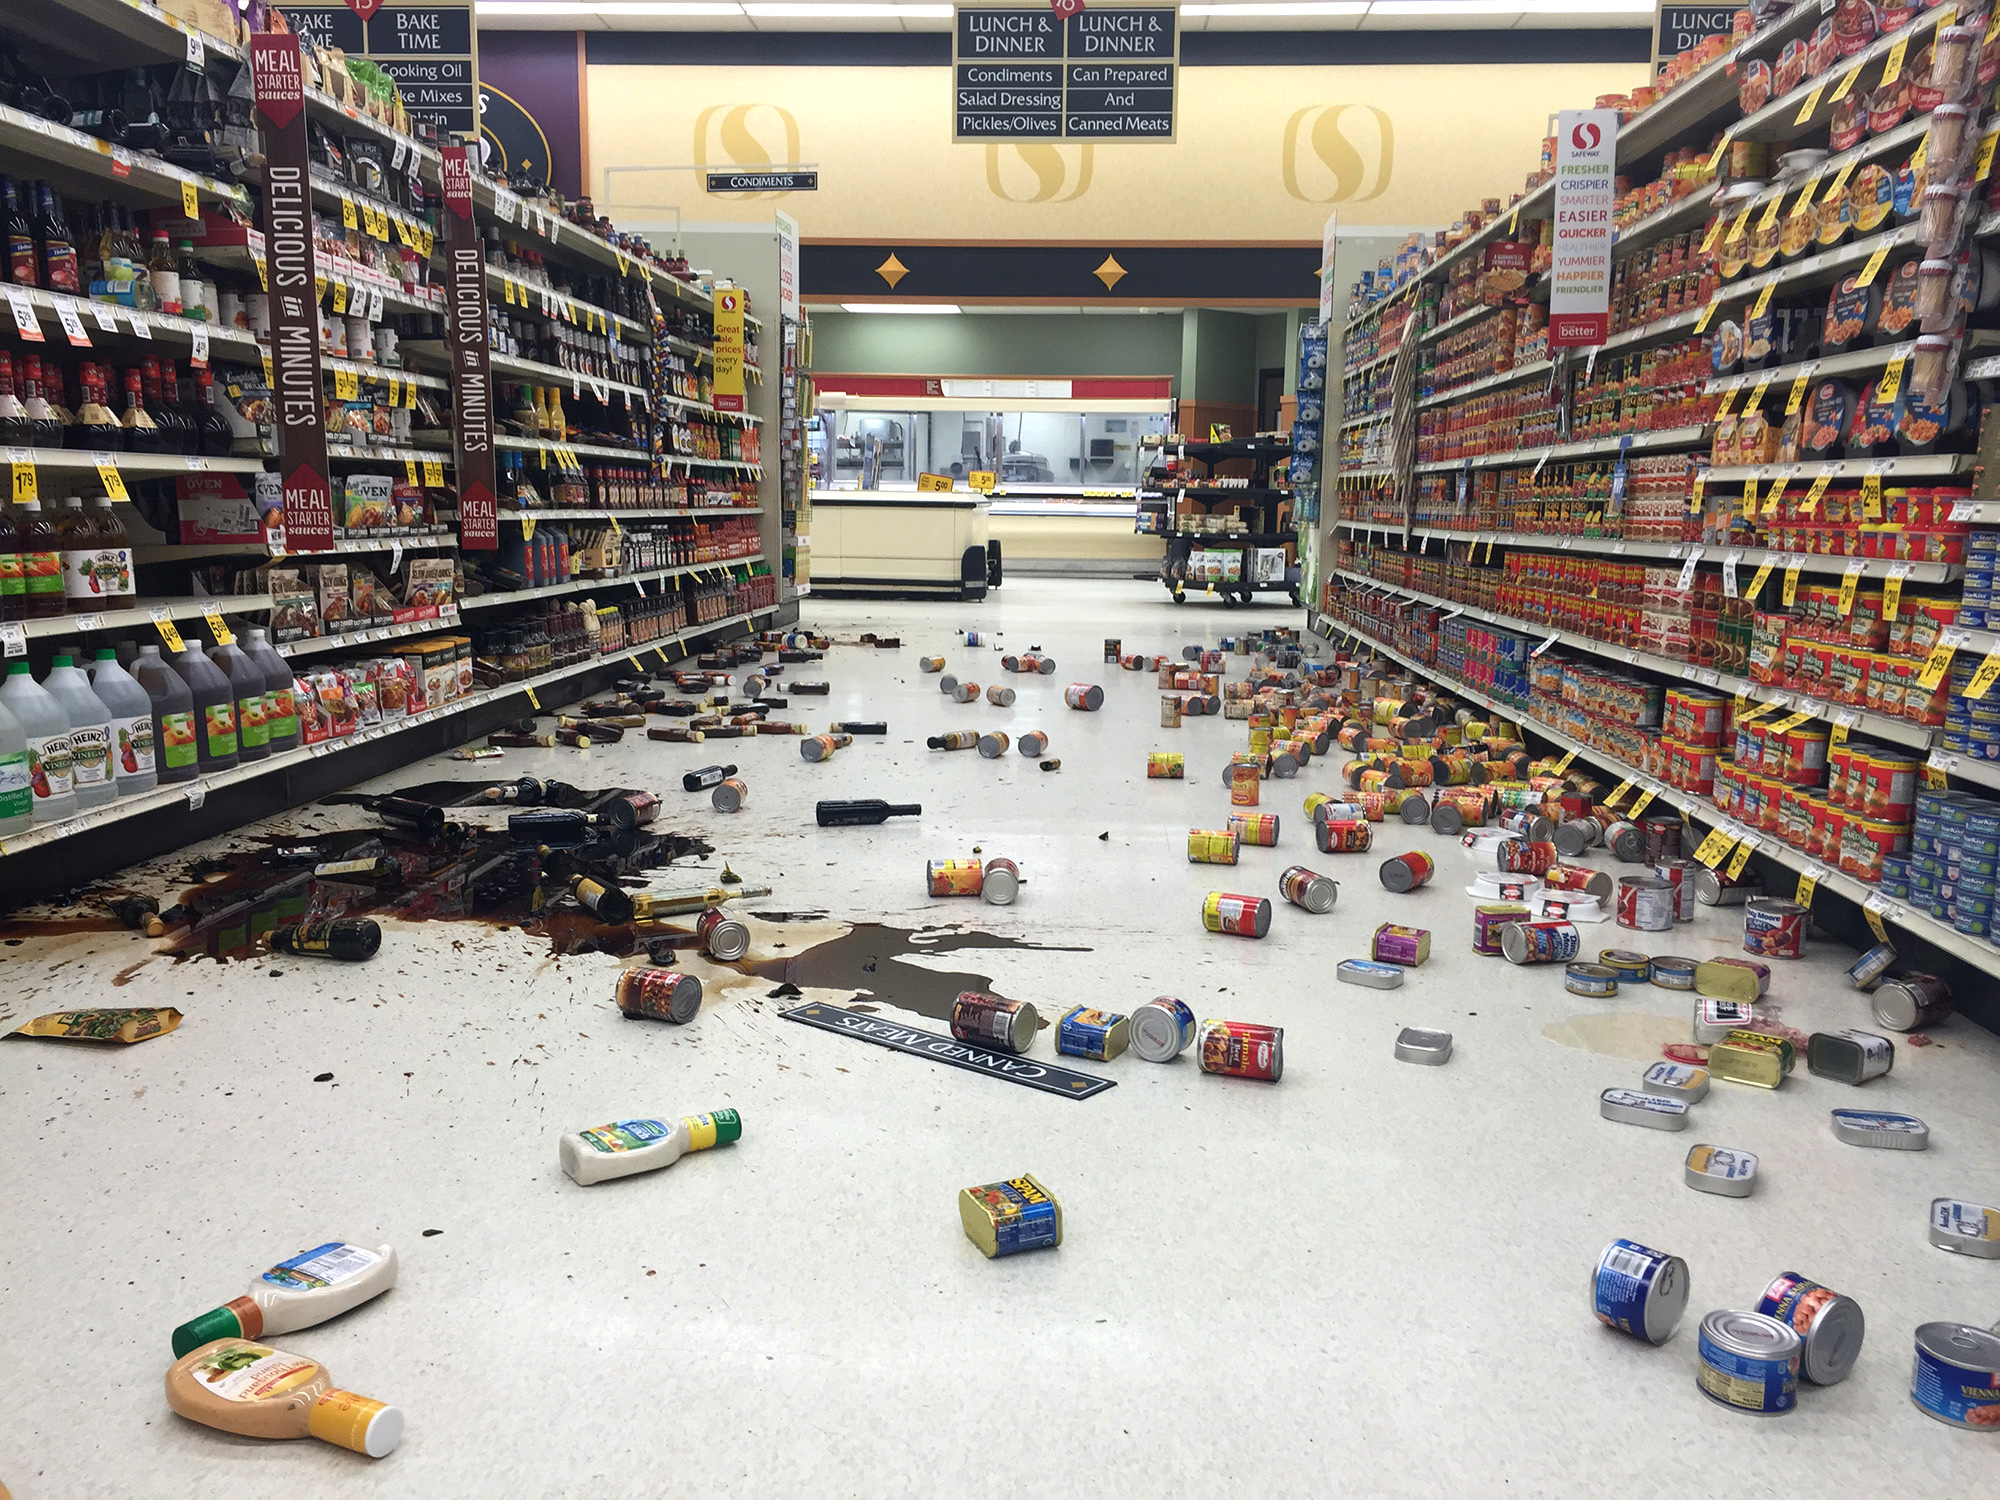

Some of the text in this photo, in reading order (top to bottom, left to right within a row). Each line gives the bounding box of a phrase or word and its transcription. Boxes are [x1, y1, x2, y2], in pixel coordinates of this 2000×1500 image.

[397, 14, 440, 30] BAKE
[969, 16, 1053, 33] LUNCH &
[1079, 16, 1163, 33] LUNCH &
[398, 33, 441, 49] TIME
[975, 36, 1046, 53] DINNER
[1085, 36, 1156, 53] DINNER
[255, 49, 299, 73] MEAL
[380, 63, 462, 81] Cooking Oil
[967, 68, 1053, 83] Condiments
[1072, 67, 1168, 85] Can Prepared
[257, 74, 301, 91] STARTER
[257, 90, 301, 101] sauces
[391, 90, 463, 104] ake Mixes
[959, 92, 1062, 110] Salad Dressing
[1104, 92, 1135, 107] And
[962, 116, 1057, 132] Pickles/Olives
[1068, 116, 1169, 131] Canned Meats
[1571, 149, 1600, 158] SAFEWAY
[445, 158, 470, 177] MEA
[1561, 164, 1609, 176] FRESHER
[730, 176, 794, 188] CONDIMENTS
[1561, 179, 1609, 190] CRISPIER
[1560, 195, 1608, 206] SMARTER
[1559, 210, 1608, 223] EASIER
[1559, 227, 1607, 239] QUICKER
[1558, 243, 1606, 254] HEALTHIER
[1558, 255, 1606, 267] YUMMIER
[1556, 270, 1604, 281] HAPPIER
[269, 166, 317, 427] DELICIOUS in MINUTES
[1556, 285, 1604, 294] FRIENDLIER
[716, 325, 740, 334] Great
[1561, 324, 1595, 337] better
[454, 249, 489, 452] DELICIOUS in MINUTES
[715, 345, 741, 355] prices
[715, 356, 739, 366] every
[715, 365, 733, 374] day!
[1881, 369, 1901, 395] 299
[15, 472, 34, 495] 179
[104, 474, 121, 494] 179
[186, 479, 223, 490] OVEN
[285, 488, 330, 511] MEAL
[1863, 484, 1879, 508] 299
[463, 500, 495, 518] MEAL
[287, 511, 331, 526] STARTER
[463, 518, 496, 530] STARTER
[288, 525, 330, 536] sauces
[463, 530, 496, 538] sauces
[1925, 653, 1947, 678] 199
[1973, 663, 1997, 688] 125
[135, 722, 153, 733] HEINZ
[73, 732, 101, 745] HEINZ
[72, 748, 106, 761] VINEGAR
[44, 758, 71, 771] VINEGA
[834, 1015, 931, 1046] MEATS
[1731, 1030, 1783, 1045] SPAM
[927, 1040, 1047, 1079] CANNED
[1233, 1043, 1241, 1062] Beef
[1241, 1032, 1251, 1074] Tamales
[1008, 1177, 1050, 1205] SPAM
[1774, 1291, 1794, 1324] ENNA
[250, 1361, 283, 1380] Island
[238, 1363, 291, 1400] Thousand
[1961, 1385, 2000, 1398] VIENNA
